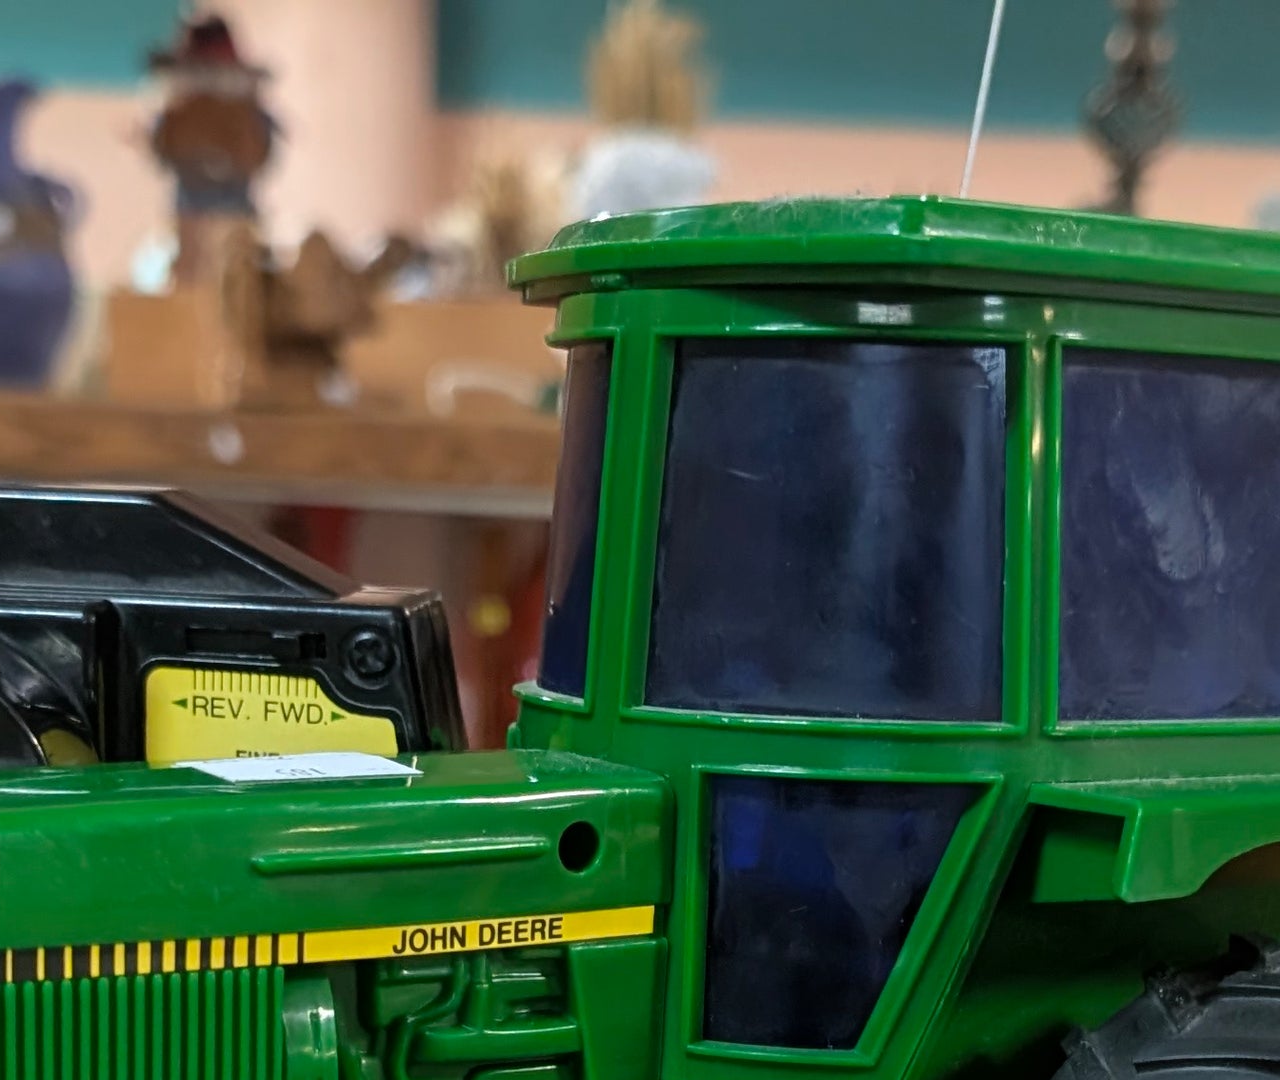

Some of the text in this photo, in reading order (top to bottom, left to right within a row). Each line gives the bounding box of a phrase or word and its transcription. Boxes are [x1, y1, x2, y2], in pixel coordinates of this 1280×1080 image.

[191, 694, 328, 726] REV. FWD.
[392, 916, 563, 954] JOHN DEERE
